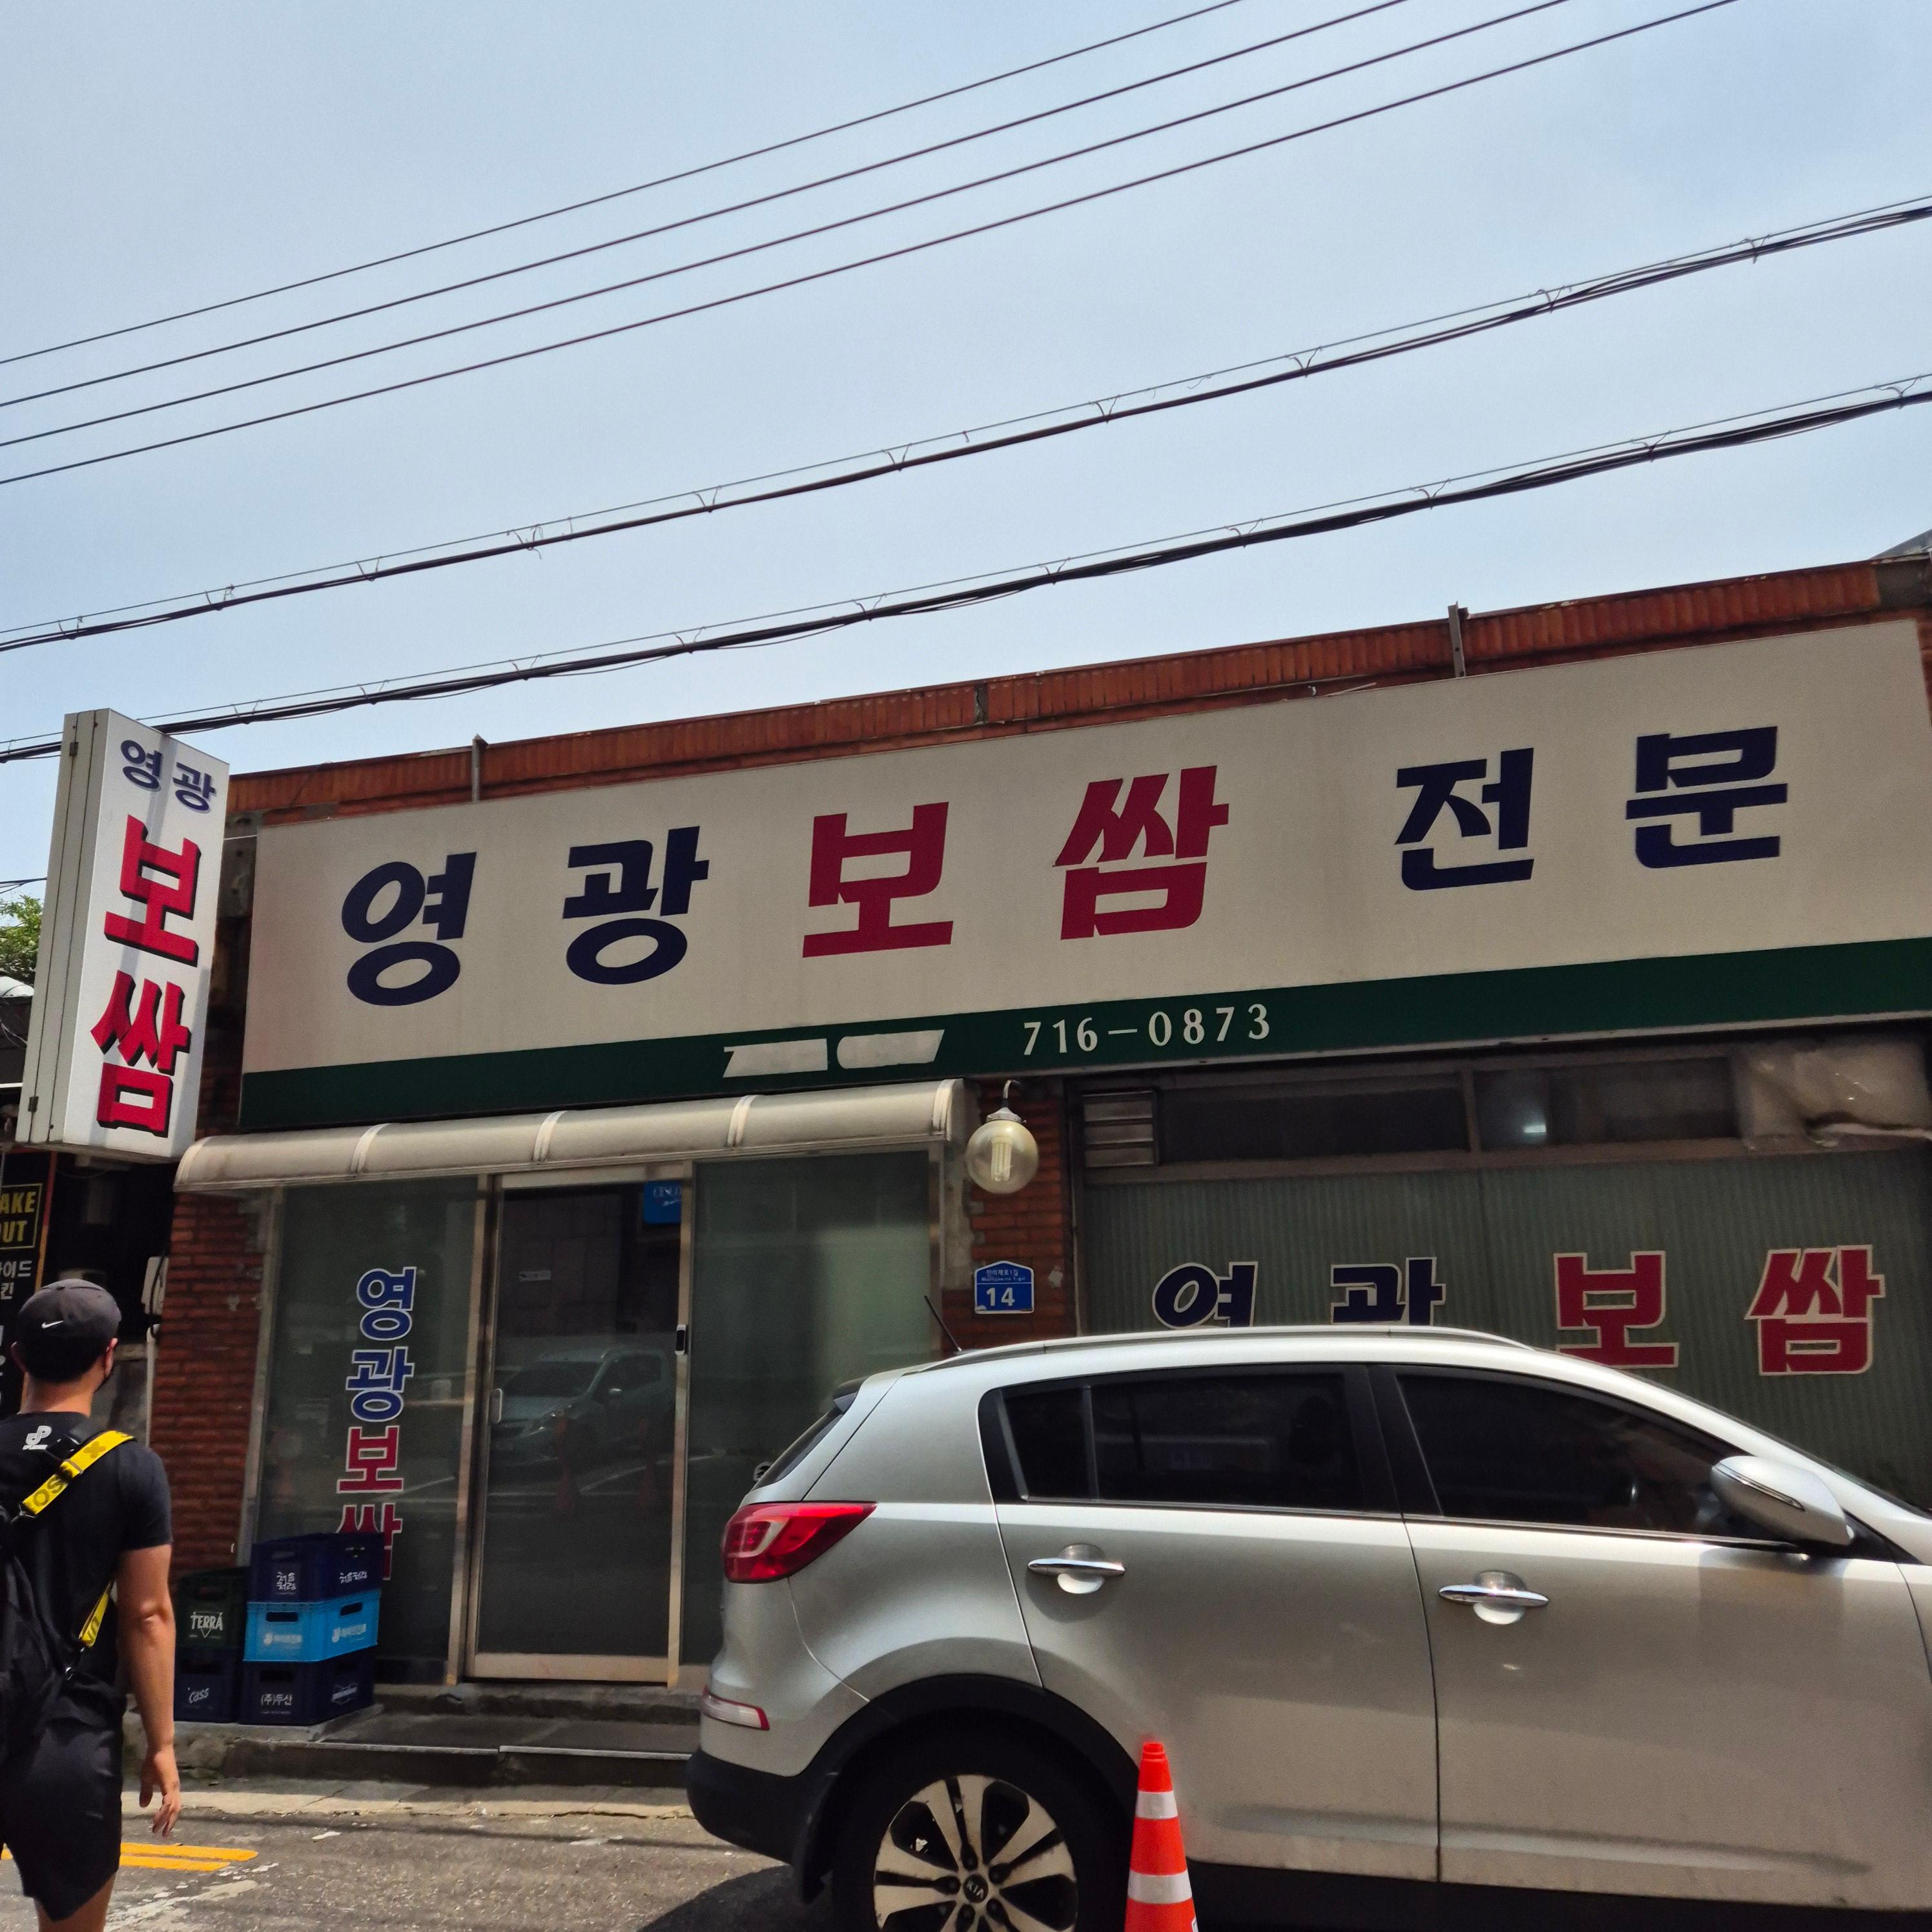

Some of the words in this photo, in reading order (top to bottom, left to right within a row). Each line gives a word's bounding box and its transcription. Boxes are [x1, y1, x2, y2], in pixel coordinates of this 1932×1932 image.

[121, 739, 217, 812] 영광
[341, 825, 710, 1007] 영광
[802, 766, 1229, 958] 보쌈
[1394, 725, 1789, 892] 전문
[90, 814, 202, 1138] 보쌈
[1023, 1003, 1270, 1056] 716-0873
[0, 1220, 27, 1242] UT
[986, 1288, 1015, 1306] 14
[1553, 1244, 1886, 1376] 보쌈
[345, 1266, 417, 1422] 영광
[190, 1612, 223, 1631] TERRA
[967, 1880, 985, 1899] KIA
